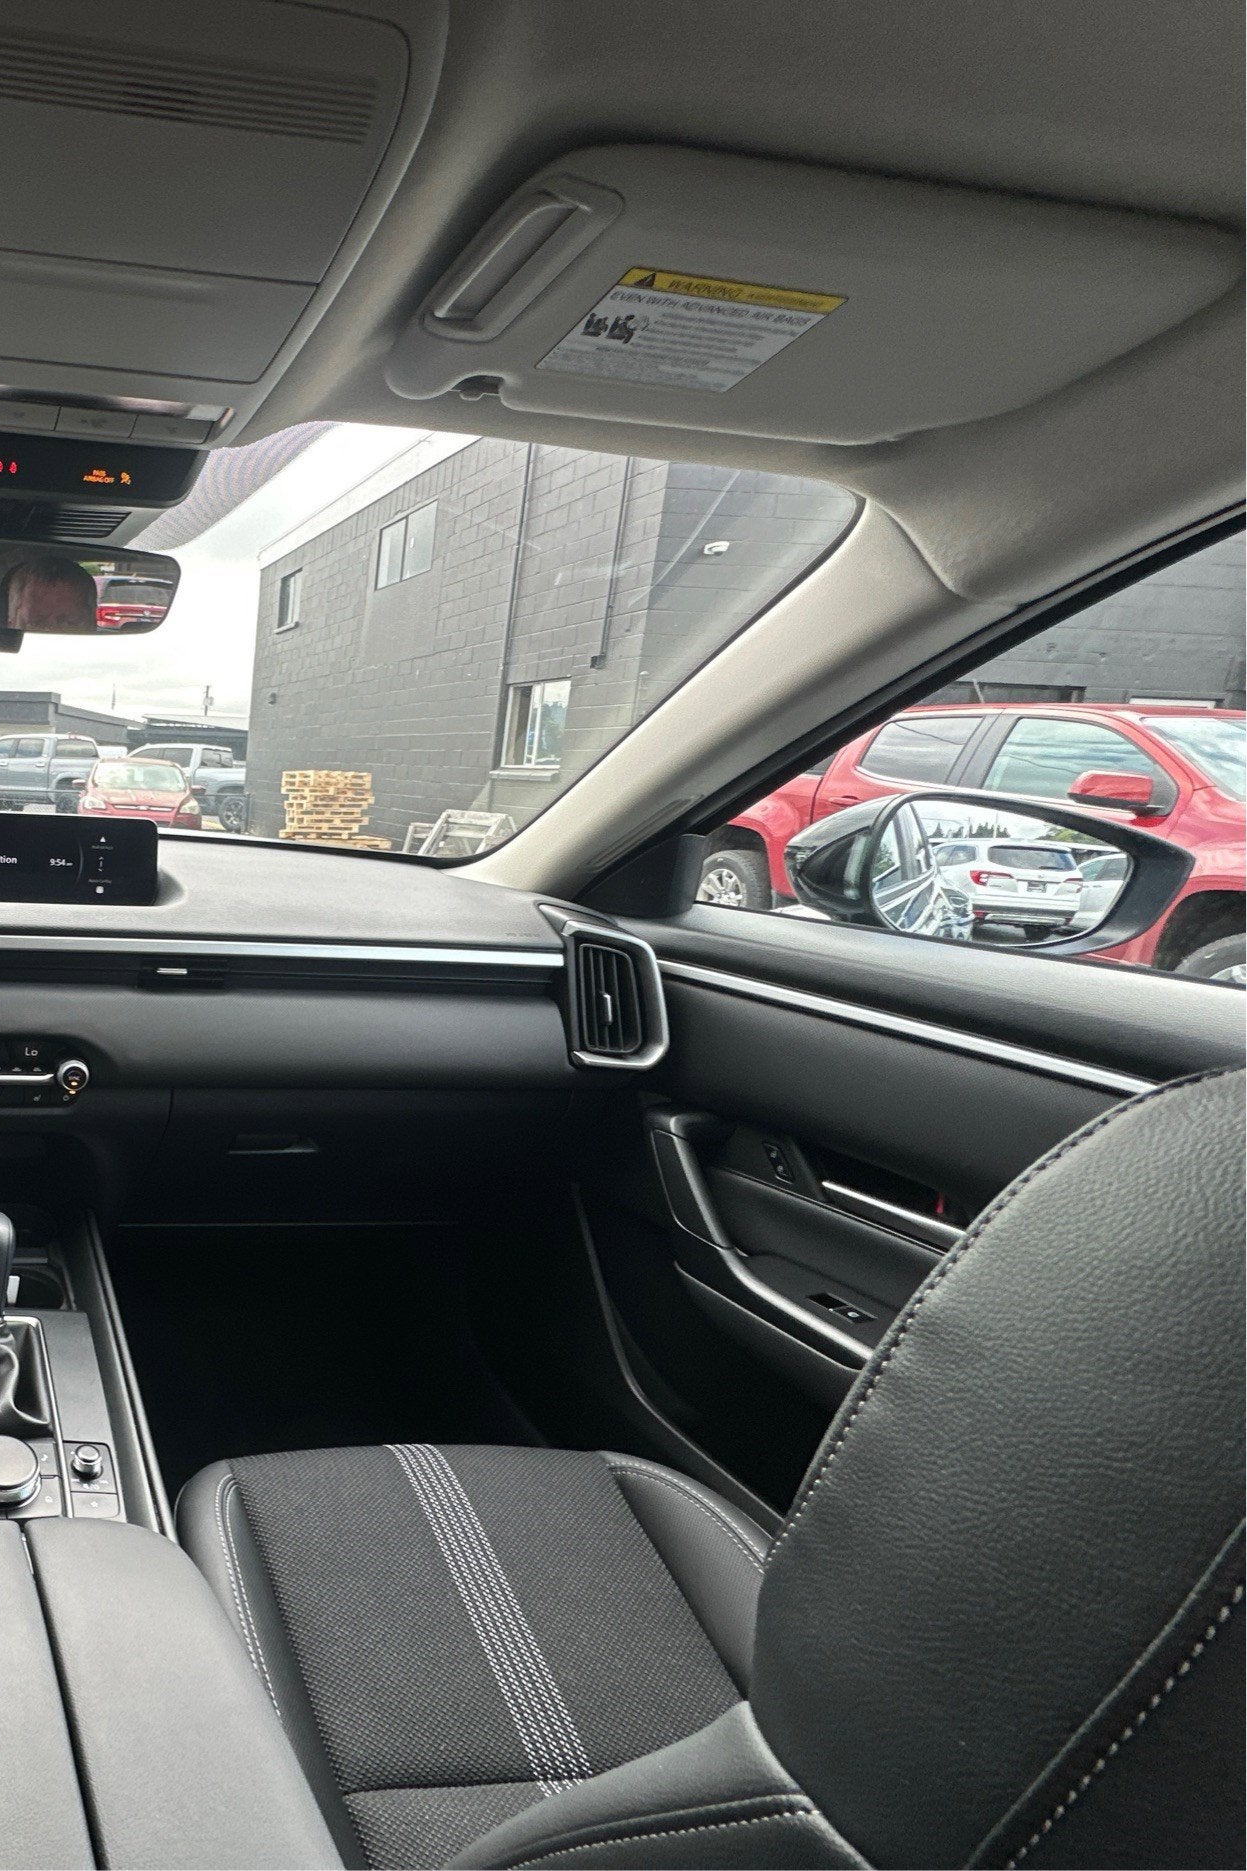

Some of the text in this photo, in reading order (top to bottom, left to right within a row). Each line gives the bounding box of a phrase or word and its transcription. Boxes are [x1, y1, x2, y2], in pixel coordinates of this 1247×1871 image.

[667, 278, 745, 299] WARNING
[609, 289, 644, 304] EVEN
[644, 294, 679, 309] WITH
[682, 299, 748, 319] ADVANCED
[25, 1046, 39, 1057] Lo
